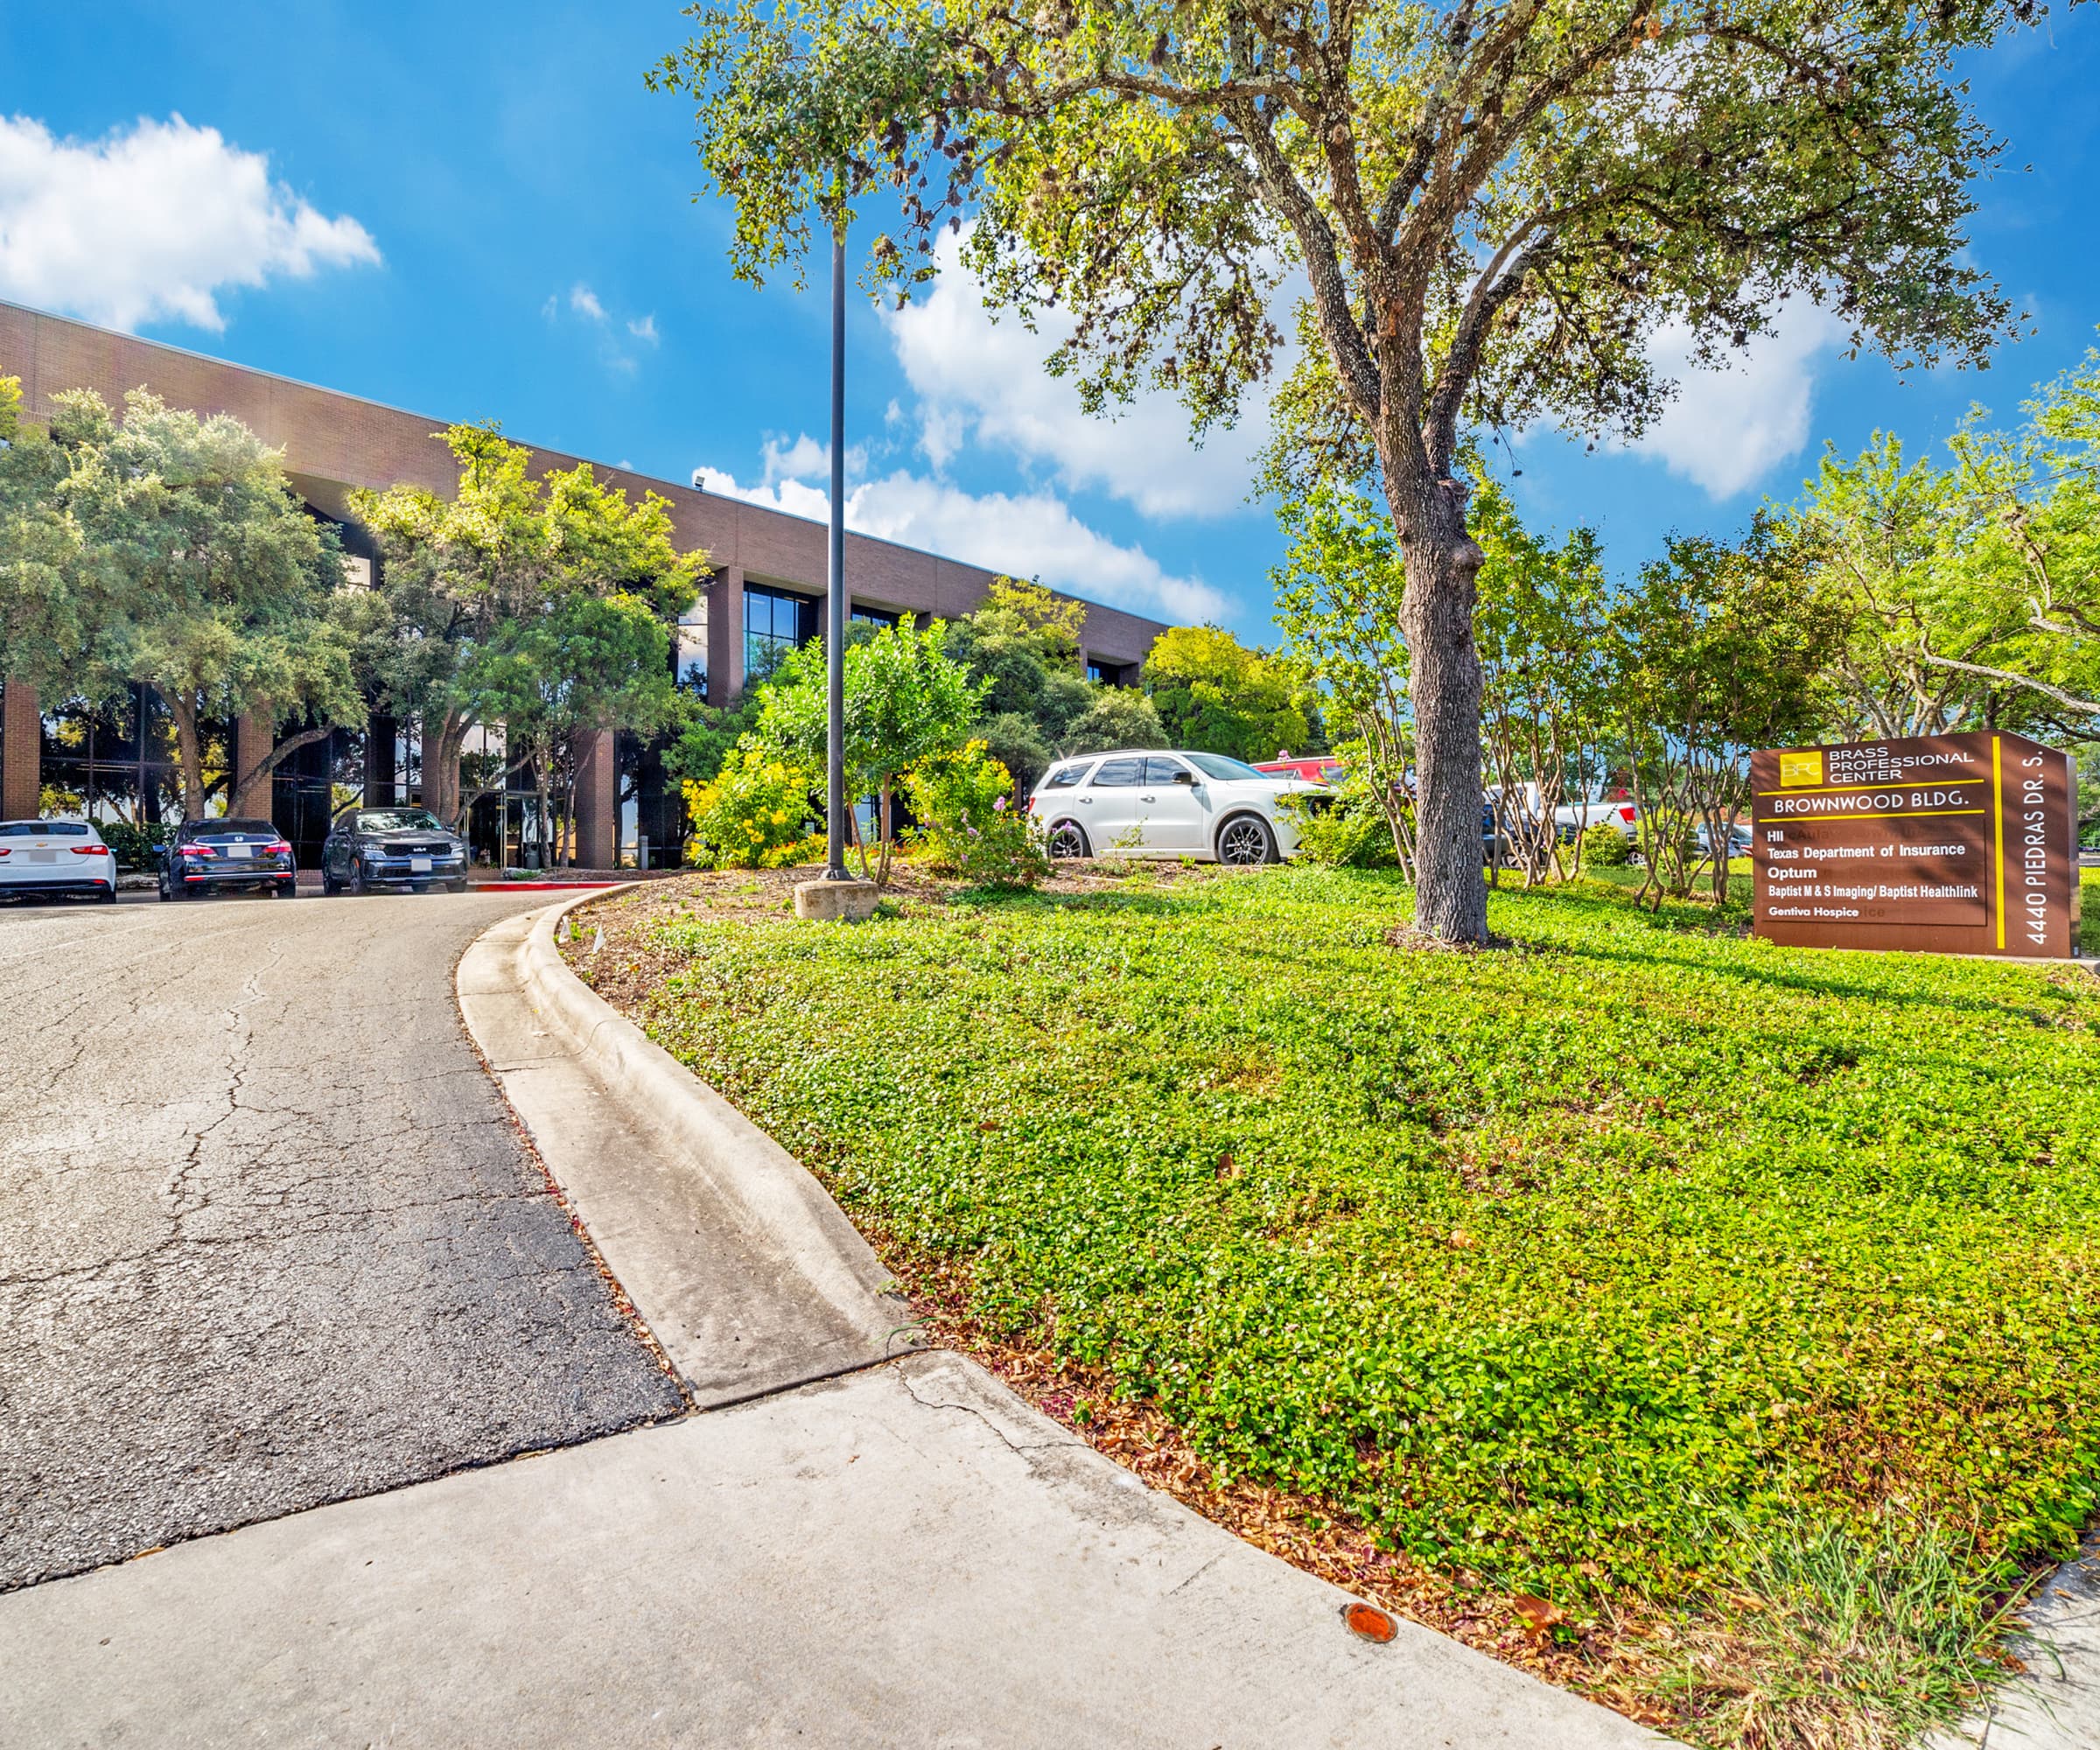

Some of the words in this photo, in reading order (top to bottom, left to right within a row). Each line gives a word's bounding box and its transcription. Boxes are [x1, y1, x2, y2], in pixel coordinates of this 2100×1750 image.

[1830, 747, 1888, 760] BRASS
[2022, 752, 2044, 767] S.
[1830, 752, 1974, 772] PROFESSIONAL
[1830, 770, 1903, 783] CENTER
[2023, 773, 2044, 805] DR.
[1774, 794, 1904, 813] BROWNWOOD
[1911, 790, 1970, 808] BLDG.
[1768, 848, 1800, 859] Texas
[1803, 846, 1875, 861] Department
[1880, 844, 1894, 857] of
[1900, 844, 1965, 857] Insurance
[2024, 811, 2046, 886] PIEDRAS
[1768, 867, 1817, 881] Optum
[1768, 886, 1802, 899] Baptist
[1803, 886, 1813, 897] M
[1814, 886, 1823, 897] &
[1824, 886, 1831, 897] S
[1833, 886, 1877, 900] Imaging/
[1880, 886, 1918, 900] Baptist
[1921, 886, 1978, 898] Healthlink
[1768, 906, 1810, 916] Gentiva
[1814, 906, 1859, 919] Hospice
[2026, 892, 2048, 945] 4440
